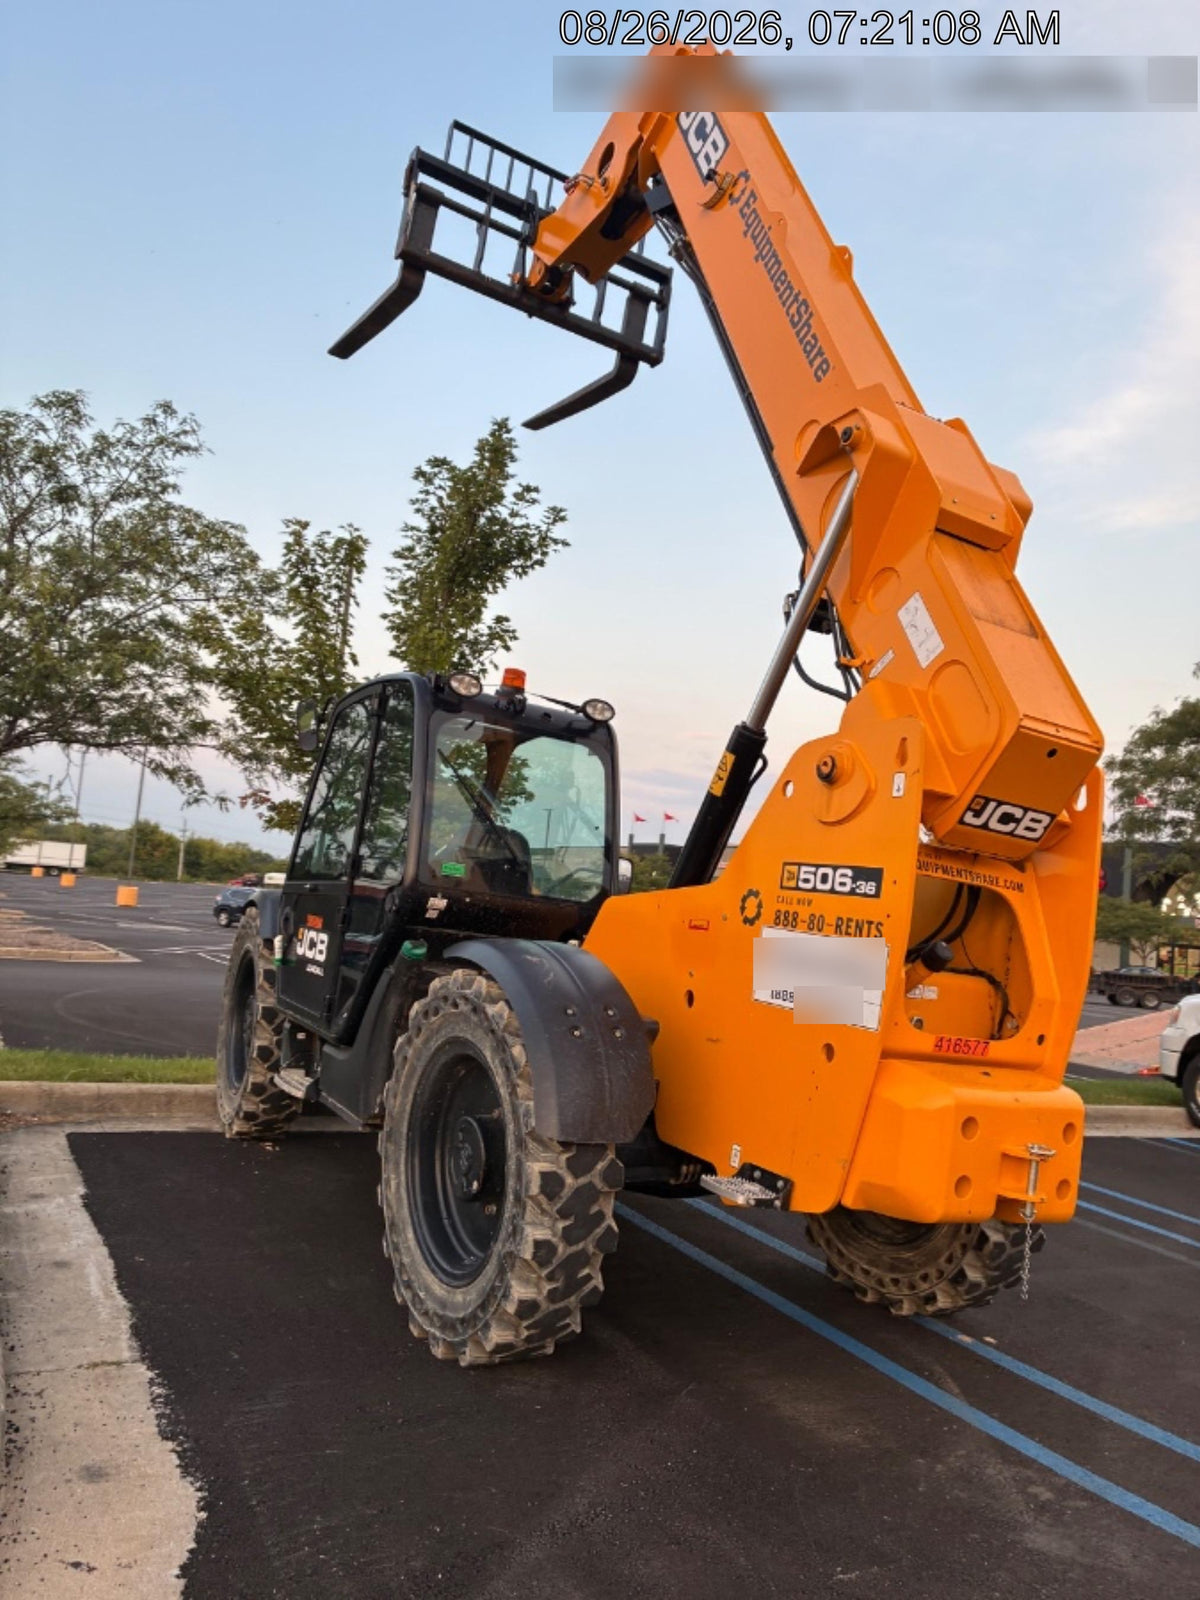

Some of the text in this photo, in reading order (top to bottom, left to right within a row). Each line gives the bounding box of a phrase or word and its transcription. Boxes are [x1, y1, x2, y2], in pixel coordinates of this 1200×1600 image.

[739, 190, 831, 383] EquipmentShare
[962, 801, 1052, 839] JCB
[917, 858, 1025, 893] QUIPMENTSHARE.COM
[773, 909, 884, 938] 888-80-RENTS
[296, 928, 328, 962] JCB
[934, 1036, 990, 1056] 416577
